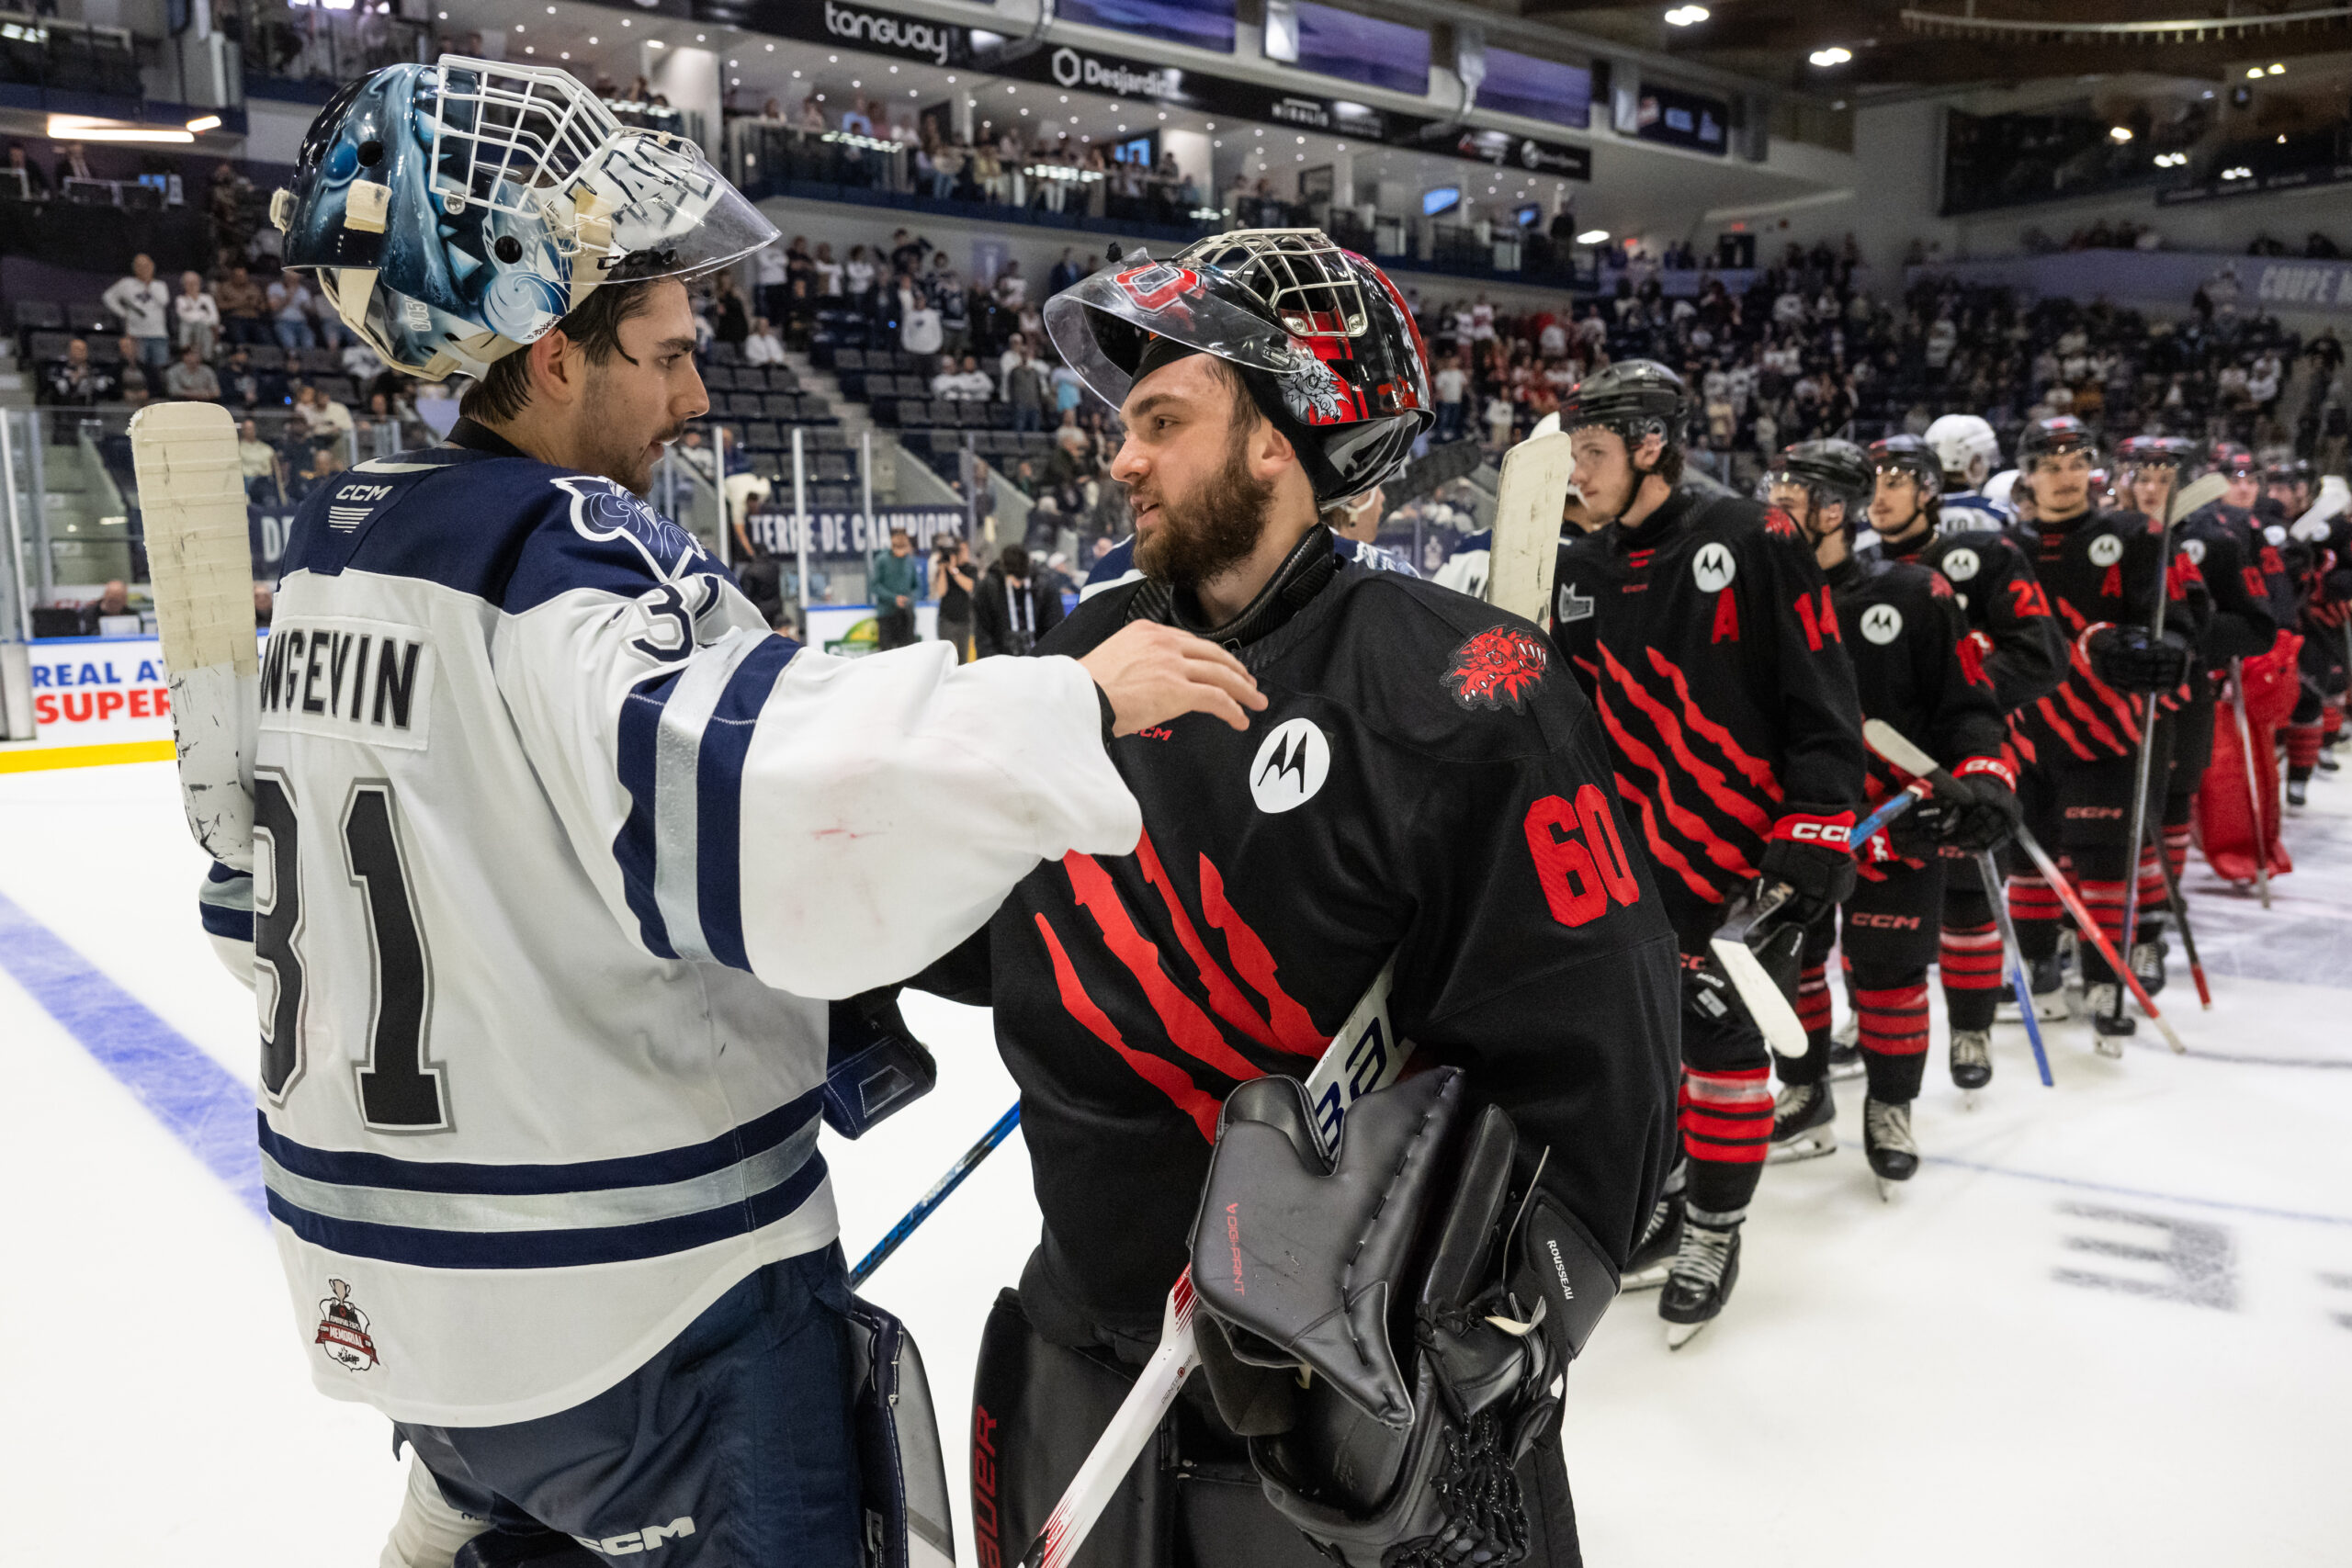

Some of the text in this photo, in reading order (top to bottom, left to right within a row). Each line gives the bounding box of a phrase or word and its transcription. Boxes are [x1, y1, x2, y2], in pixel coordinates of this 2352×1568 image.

[824, 1, 948, 65] tanguay
[1084, 58, 1181, 98] Desjardin
[335, 484, 393, 502] CCM
[820, 513, 847, 552] DE
[1712, 588, 1739, 645] A
[2008, 579, 2052, 618] 21
[31, 660, 121, 688] REAL
[1132, 726, 1173, 740] CM
[1523, 783, 1642, 930] 60
[1851, 912, 1921, 931] CCM
[1546, 1240, 1575, 1300] ROUSSEAU
